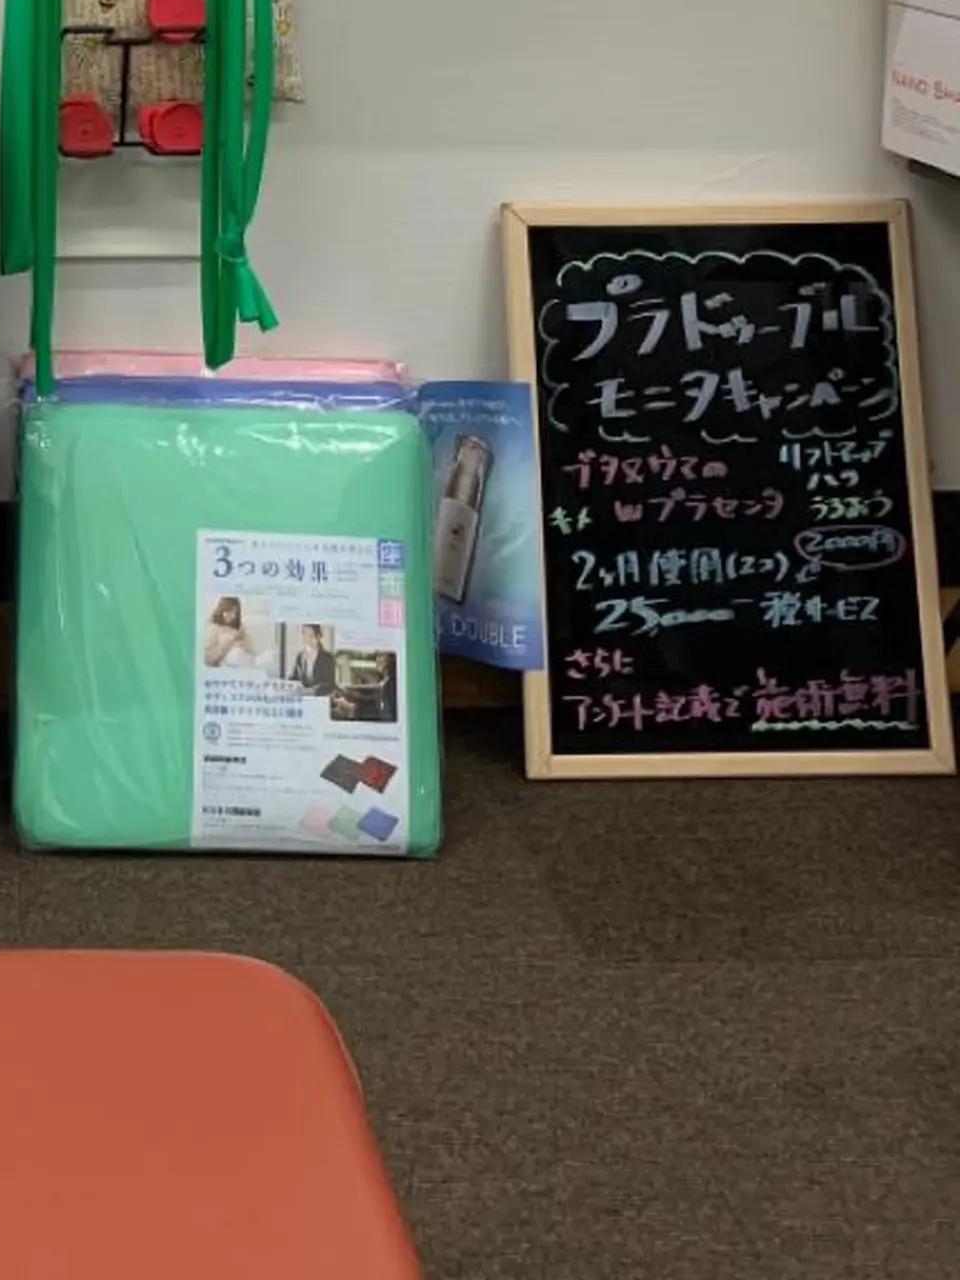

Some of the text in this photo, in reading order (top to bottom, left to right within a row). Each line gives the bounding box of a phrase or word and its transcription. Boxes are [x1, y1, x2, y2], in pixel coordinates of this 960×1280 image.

[212, 545, 330, 583] 3つの効果
[565, 648, 636, 679] さらに
